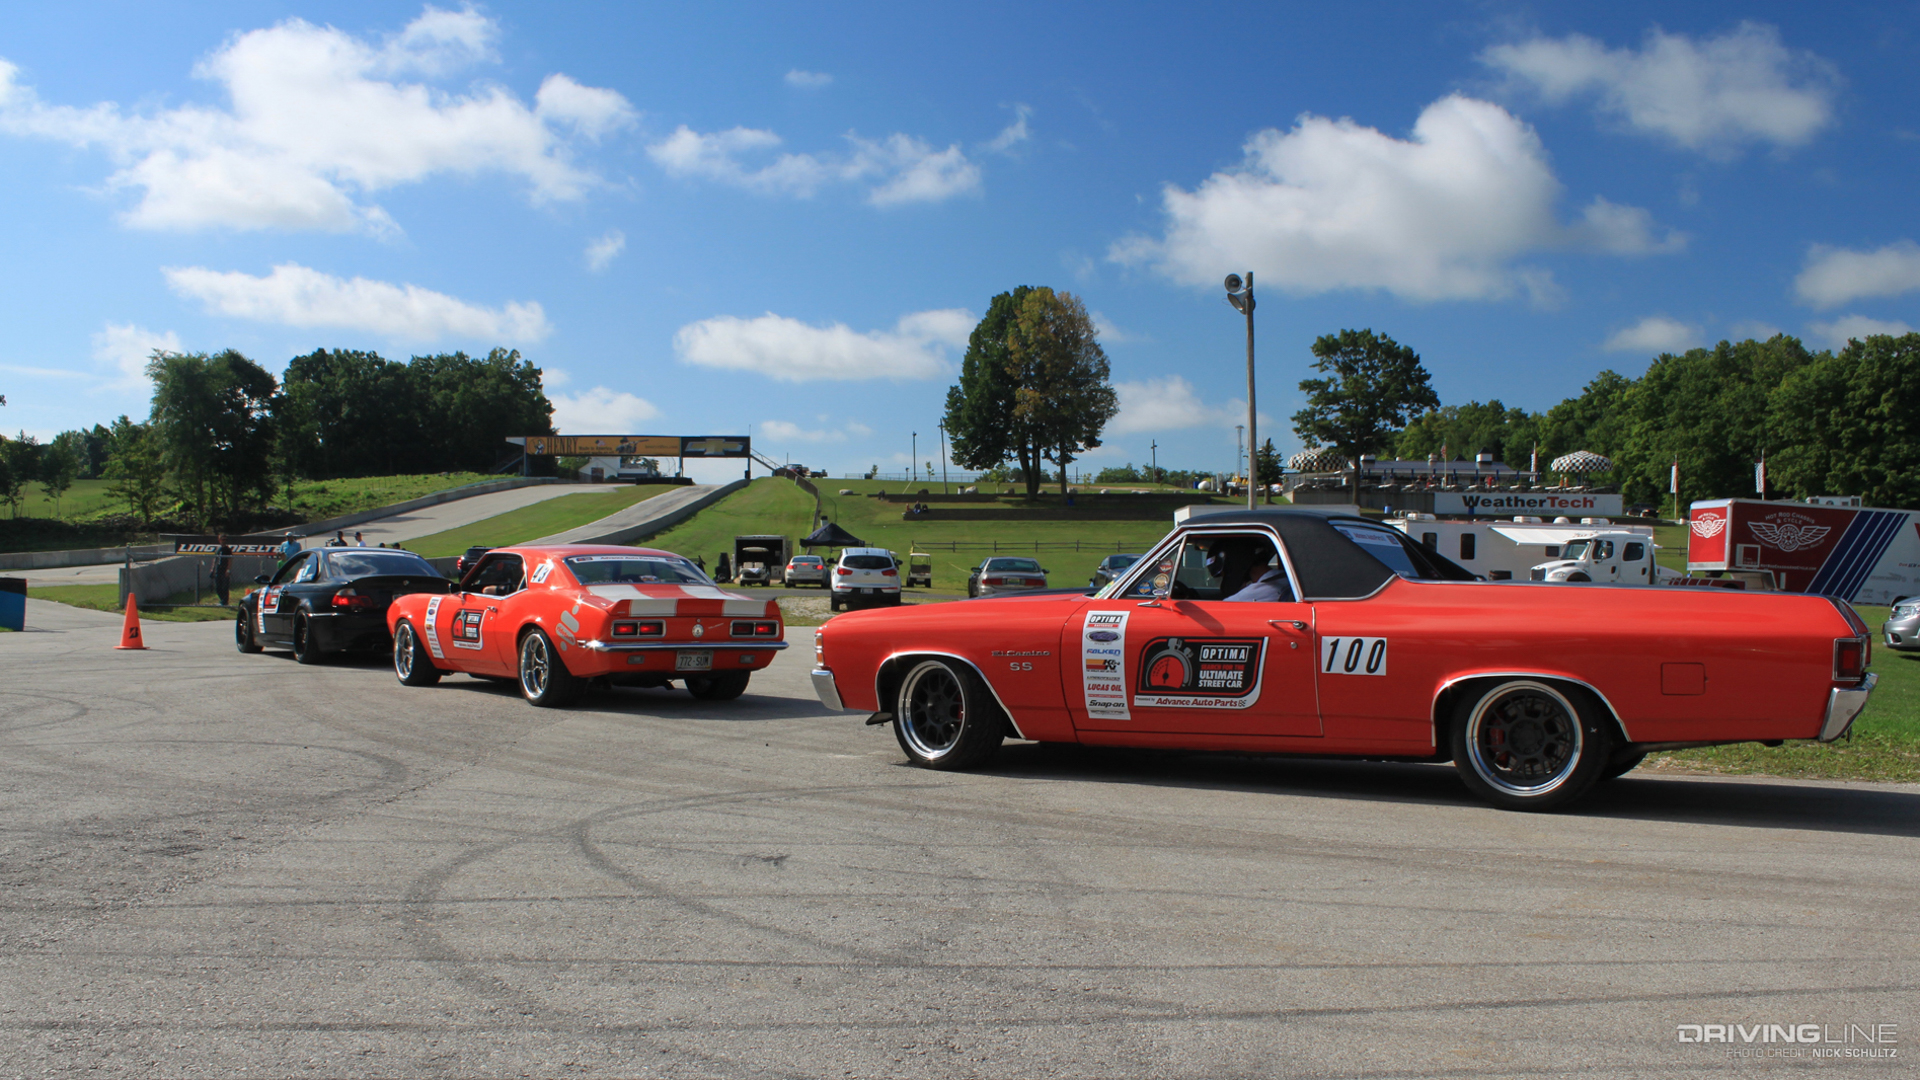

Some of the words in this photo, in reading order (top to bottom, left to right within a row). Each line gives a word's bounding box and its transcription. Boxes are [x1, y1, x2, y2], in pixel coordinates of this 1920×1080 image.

[546, 437, 578, 455] HENRY
[1462, 495, 1594, 509] WeatherTech
[1087, 648, 1121, 656] FALKEN
[1202, 648, 1246, 660] OPTIMA
[1325, 638, 1386, 674] 100
[1010, 662, 1033, 671] SS
[1199, 670, 1243, 680] ULTIMATE
[1087, 683, 1110, 691] LUCAS
[1111, 684, 1122, 692] OIL
[1198, 680, 1225, 688] STREET
[1089, 699, 1125, 708] Snap-on
[1155, 697, 1191, 706] Advance
[1191, 698, 1213, 706] Auto
[1214, 699, 1238, 707] Parts
